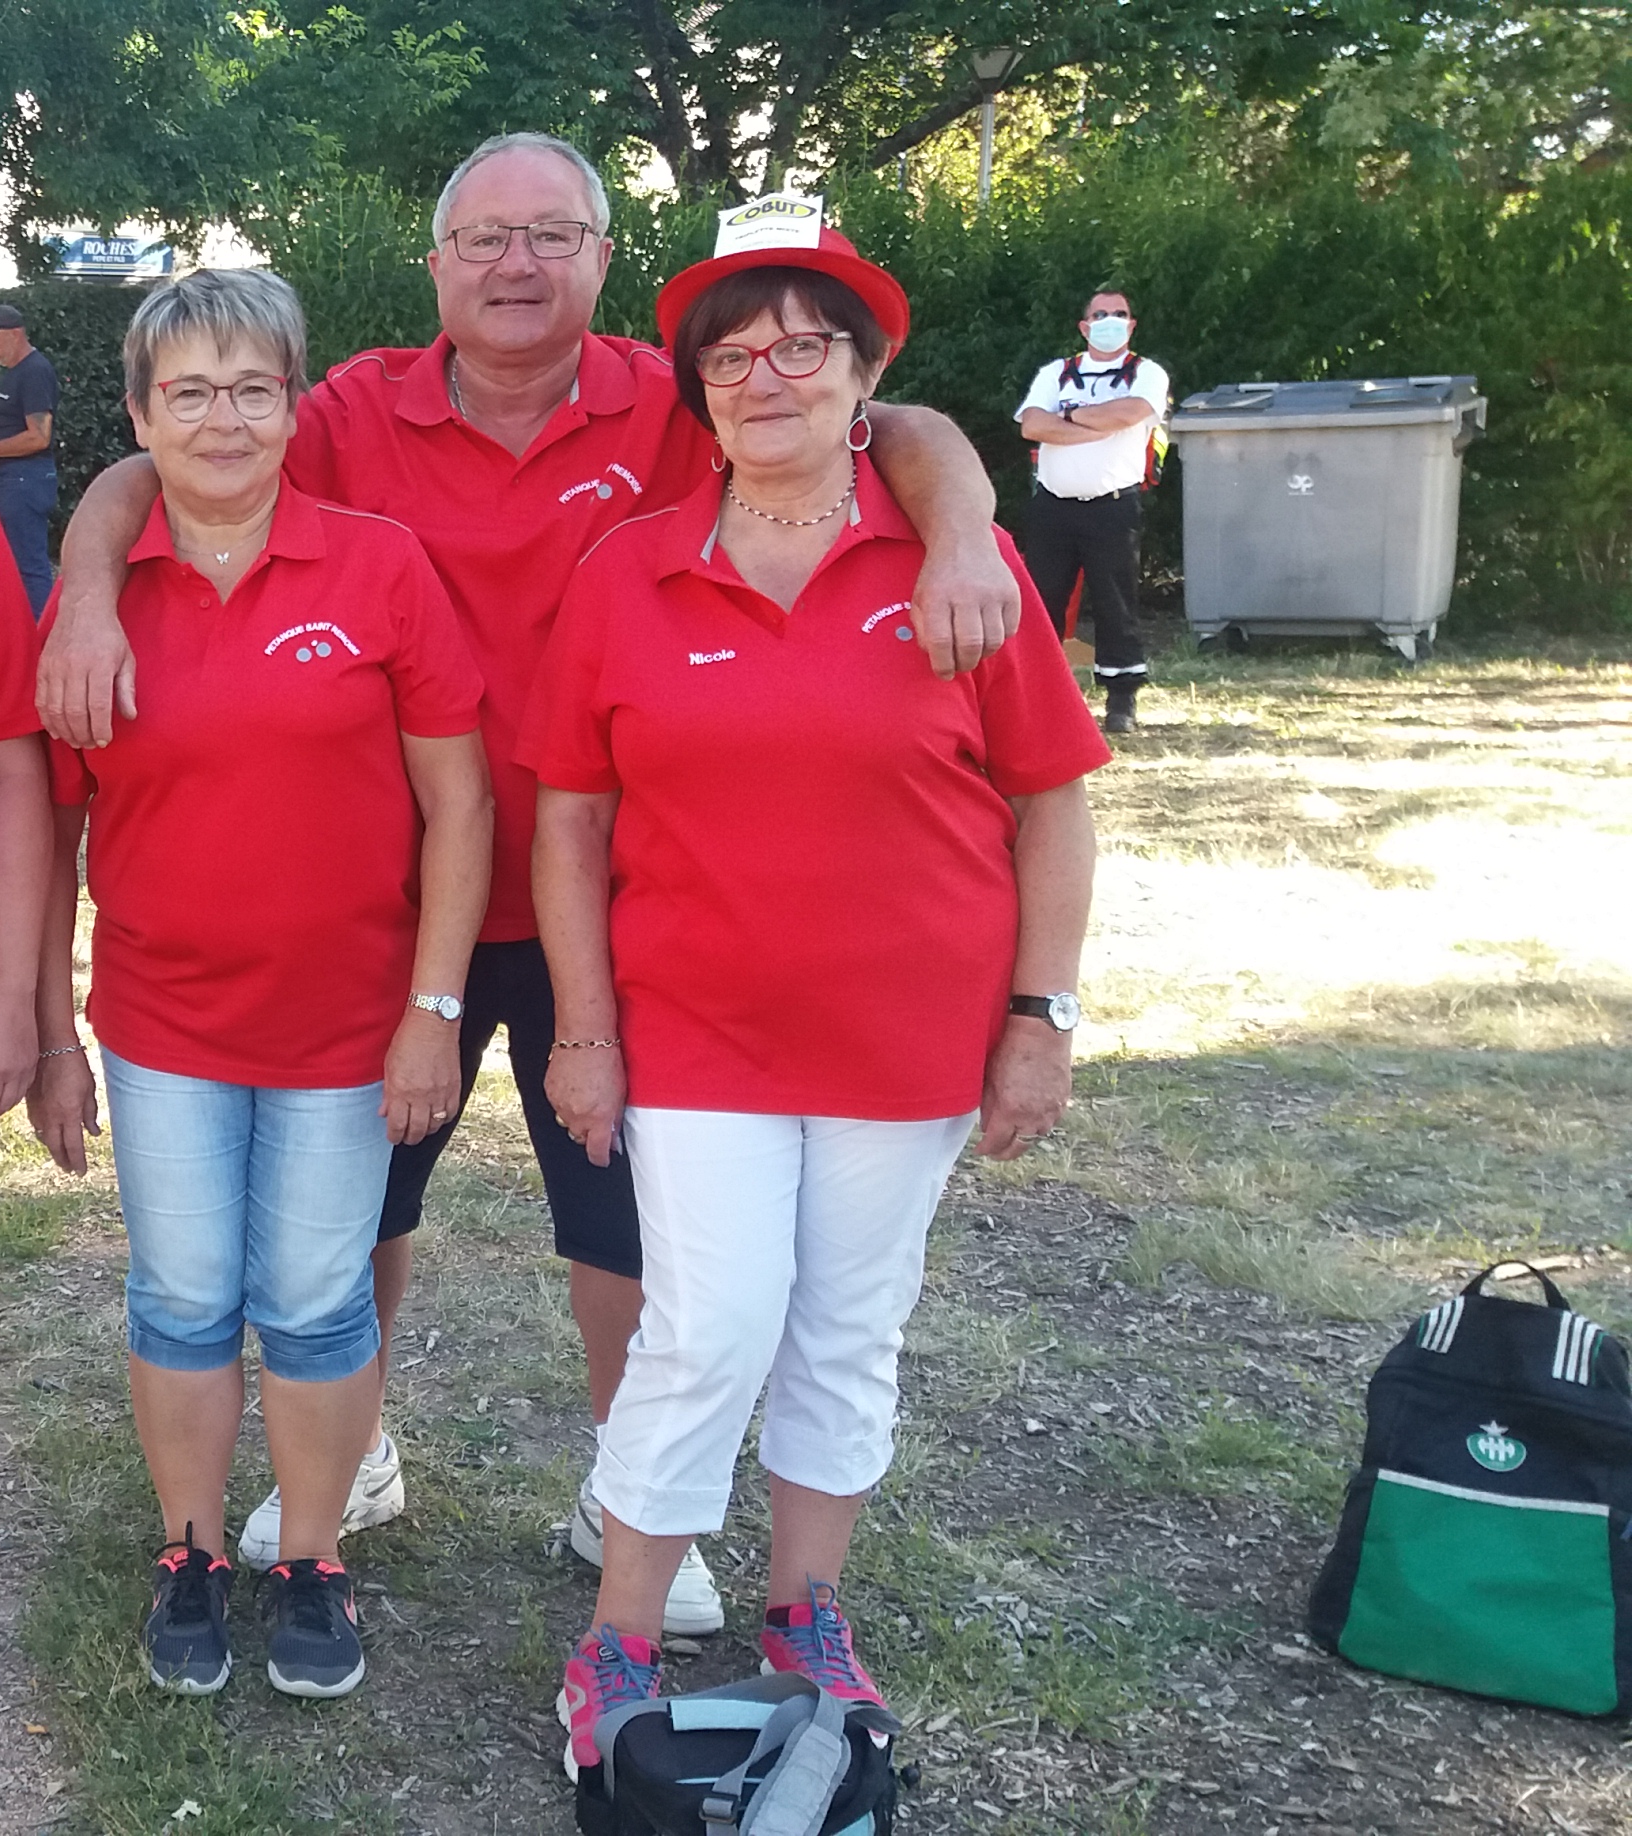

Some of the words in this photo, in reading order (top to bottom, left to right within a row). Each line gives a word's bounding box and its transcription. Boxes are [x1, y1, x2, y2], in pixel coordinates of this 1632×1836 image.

[744, 200, 798, 220] OBUT
[611, 463, 643, 496] REMOISE
[861, 603, 903, 633] PETANQUE
[264, 625, 305, 656] PETANQUE
[306, 622, 332, 632] SAINT
[331, 625, 361, 656] REMOISE
[689, 648, 736, 666] Nicole
